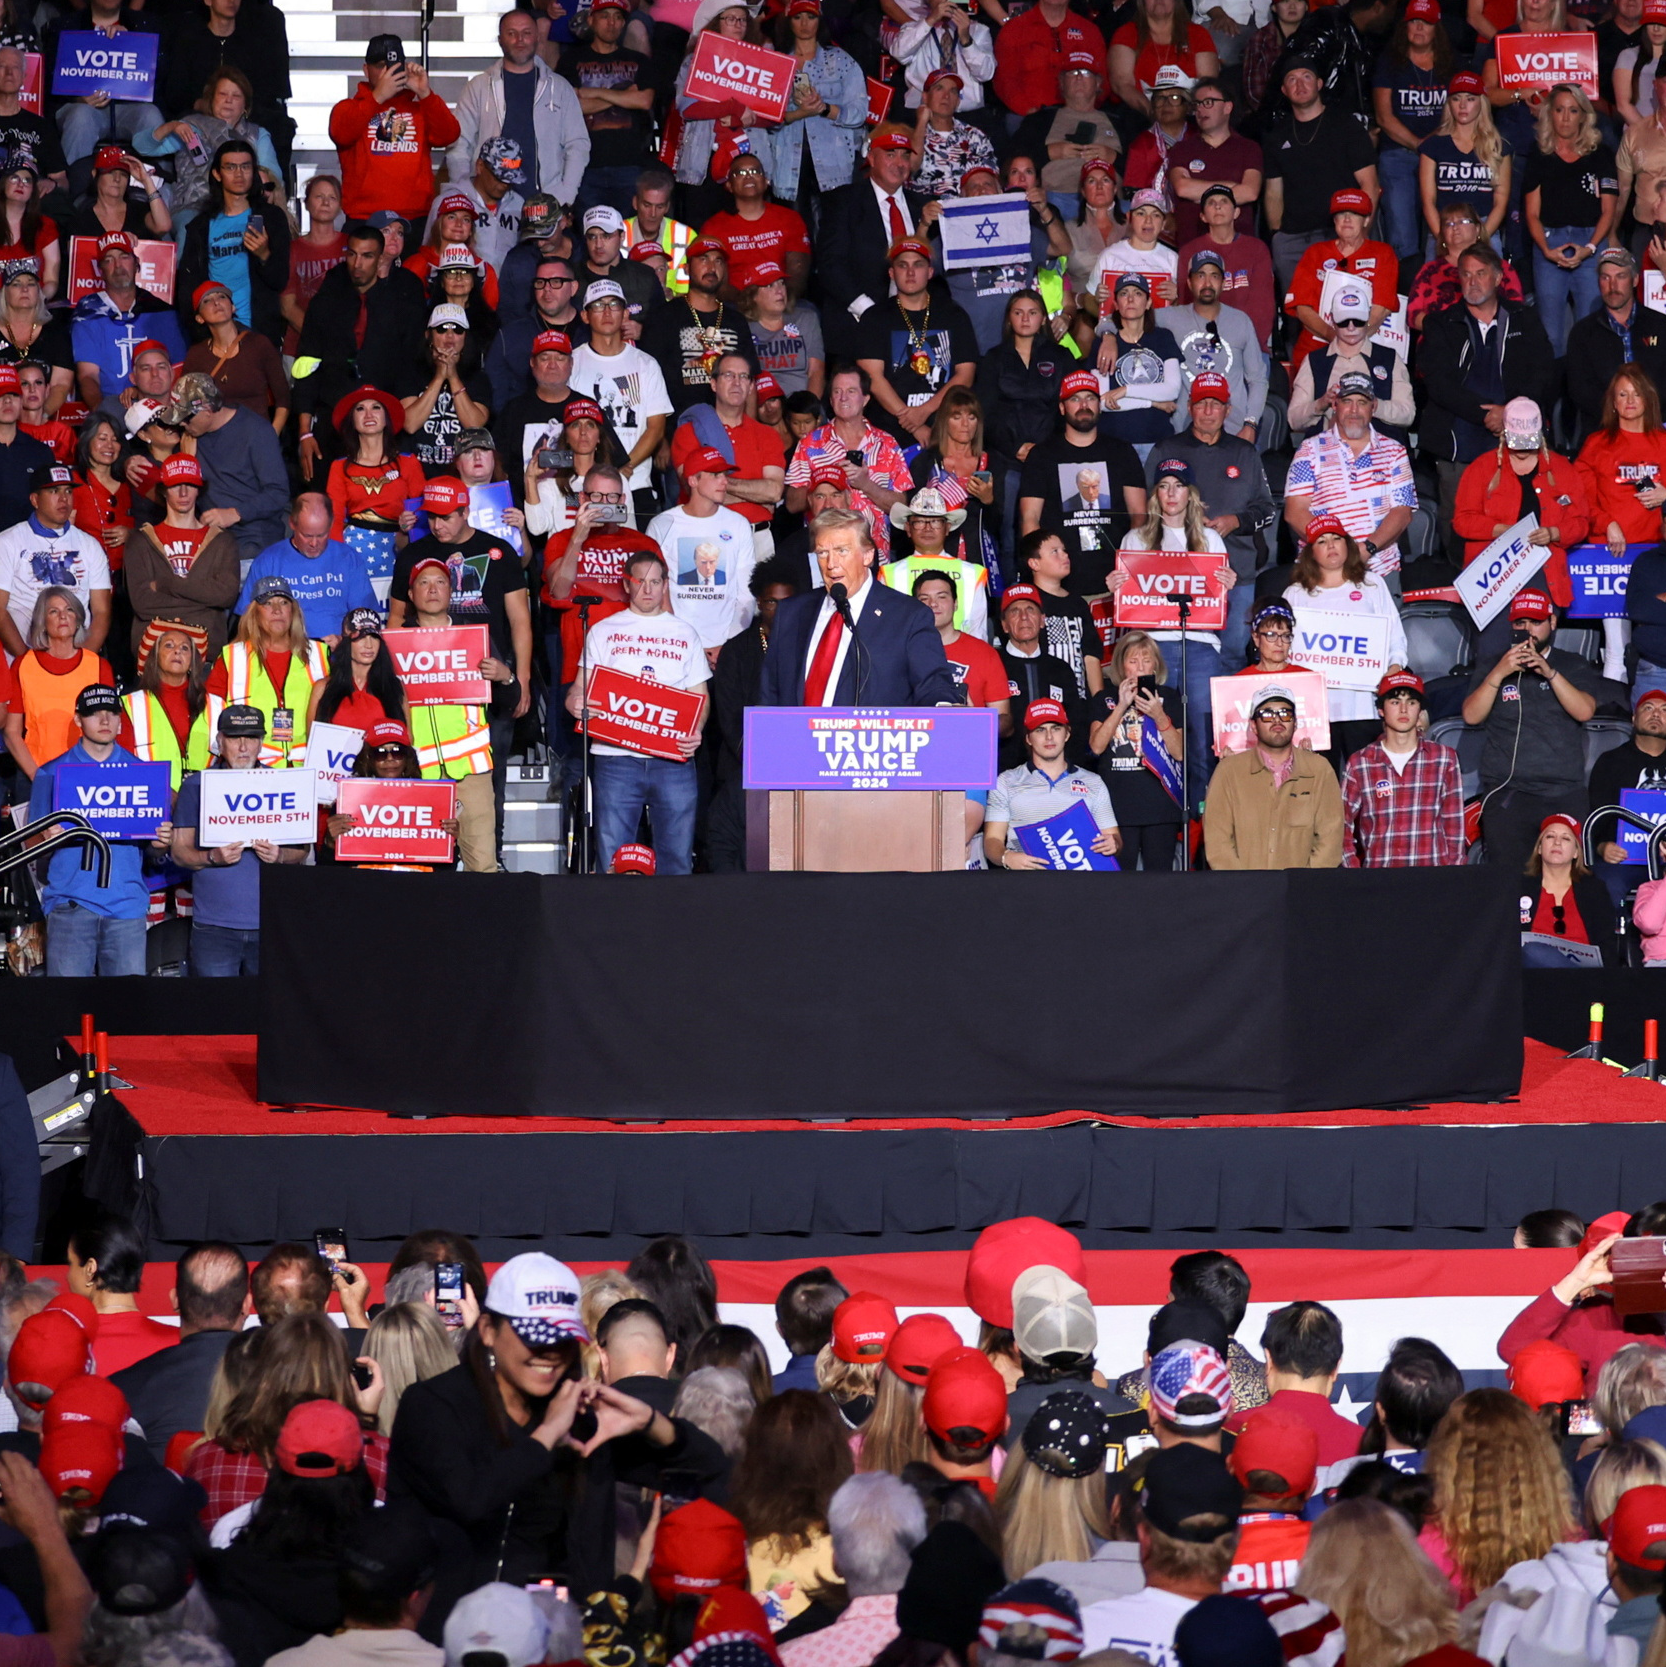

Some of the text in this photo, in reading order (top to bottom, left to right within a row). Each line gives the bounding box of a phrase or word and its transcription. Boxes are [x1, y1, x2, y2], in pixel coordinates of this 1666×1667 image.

[75, 49, 138, 70] VOTE
[1515, 52, 1579, 70] VOTE
[60, 67, 149, 82] NOVEMBER 5TH
[713, 54, 774, 89] VOTE
[1504, 69, 1592, 84] NOVEMBER 5TH
[695, 68, 782, 106] NOVEMBER 5TH
[370, 140, 419, 152] LEGENDS
[1453, 183, 1479, 193] 2016
[97, 232, 128, 246] MAGA
[424, 419, 461, 435] GUNS
[1618, 464, 1659, 480] TRUMP
[1062, 517, 1112, 527] SURRENDER!
[1073, 510, 1101, 519] NEVER
[1475, 537, 1525, 591] VOTE
[1569, 564, 1593, 576] 5TH
[301, 573, 344, 585] Can Put
[1138, 574, 1206, 594] VOTE
[1474, 559, 1521, 612] NOVEMBER
[687, 585, 715, 593] NEVER
[1008, 586, 1033, 598] TRUMP
[676, 592, 726, 602] SURRENDER!
[1195, 595, 1220, 608] 5TH
[606, 634, 689, 649] MAKE AMERICA
[1301, 632, 1369, 655] VOTE
[396, 649, 468, 671] VOTE
[611, 645, 683, 661] GREAT AGAIN
[459, 670, 483, 682] 5TH
[607, 692, 679, 726] VOTE
[814, 718, 930, 730] TRUMP WILL FIX IT
[814, 731, 930, 753] TRUMP
[826, 752, 916, 771] VANCE
[897, 770, 923, 778] AGAIN!
[851, 777, 889, 789] 2024
[76, 785, 150, 807] VOTE
[225, 792, 296, 812] VOTE
[139, 807, 163, 819] 5TH
[209, 811, 311, 826] NOVEMBER 5TH
[359, 804, 433, 827] VOTE
[420, 826, 448, 840] 5TH
[1056, 828, 1094, 871] VOT
[524, 1291, 578, 1306] TRUMP
[853, 1331, 885, 1342] TRUMP
